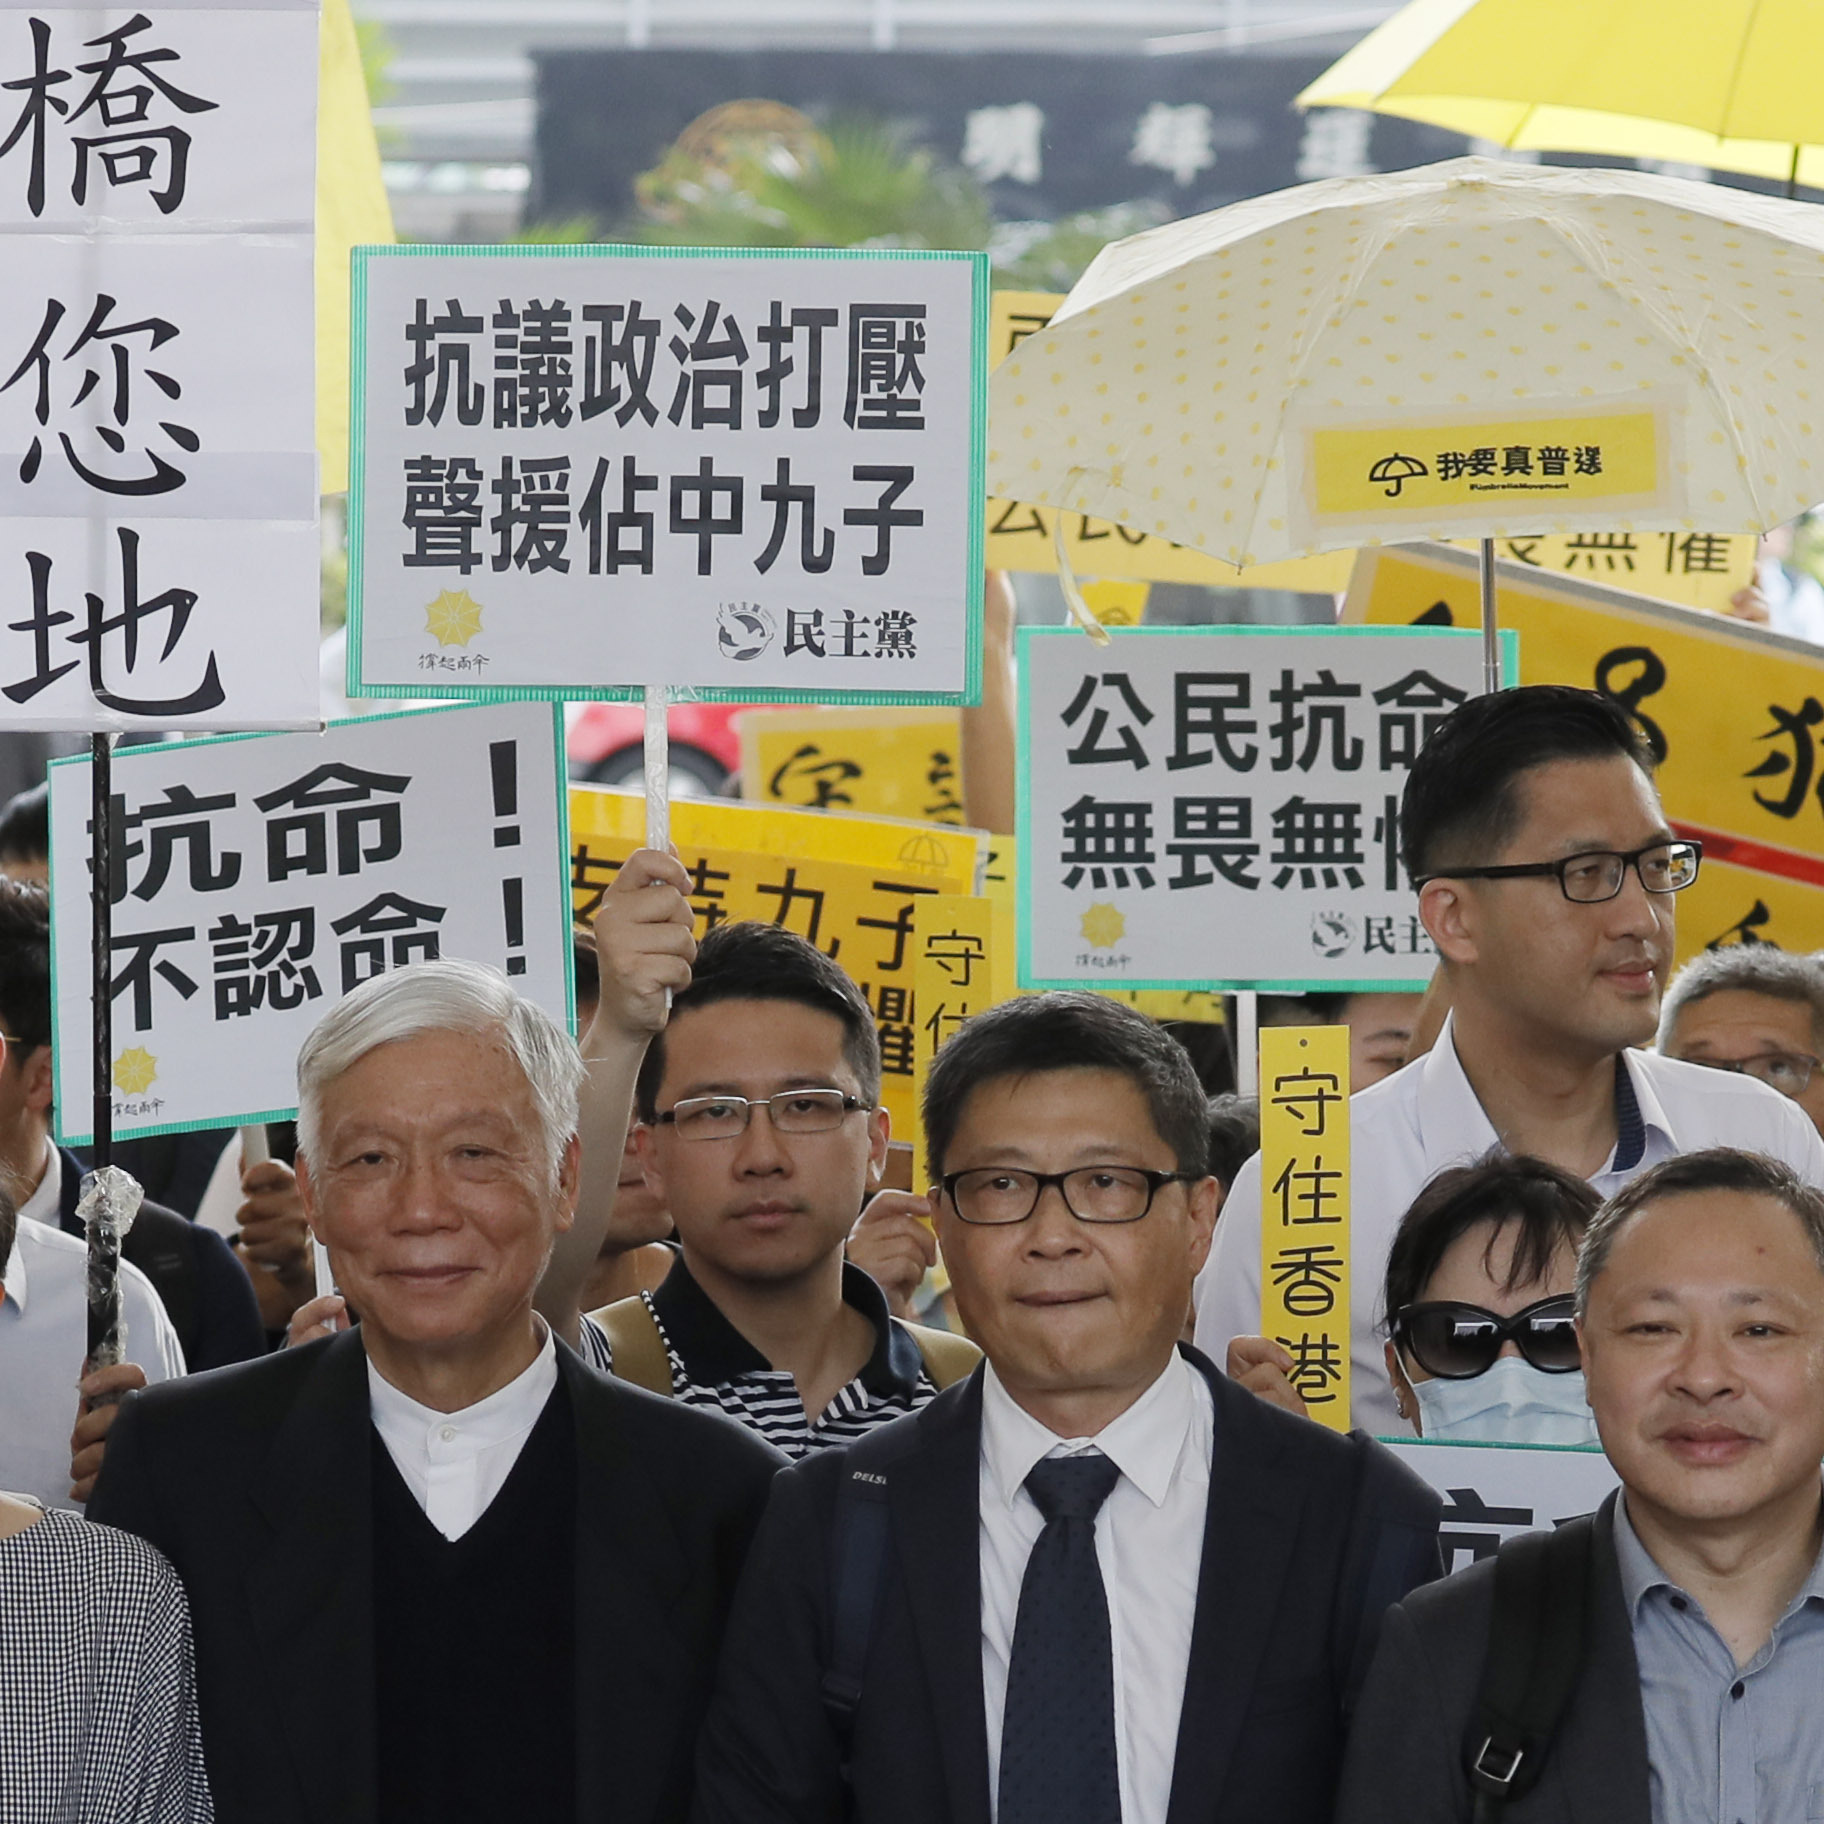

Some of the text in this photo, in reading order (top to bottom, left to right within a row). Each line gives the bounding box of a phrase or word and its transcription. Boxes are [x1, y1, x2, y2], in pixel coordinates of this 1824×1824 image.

[403, 297, 927, 431] 抗議政治打壓
[1435, 446, 1603, 482] 我要真普選
[401, 454, 925, 577] 聲援佔中九子
[783, 607, 919, 660] 民主黨
[1060, 794, 1409, 892] 無畏無
[1363, 916, 1442, 957] 民主
[1271, 1066, 1344, 1404] 守住香港
